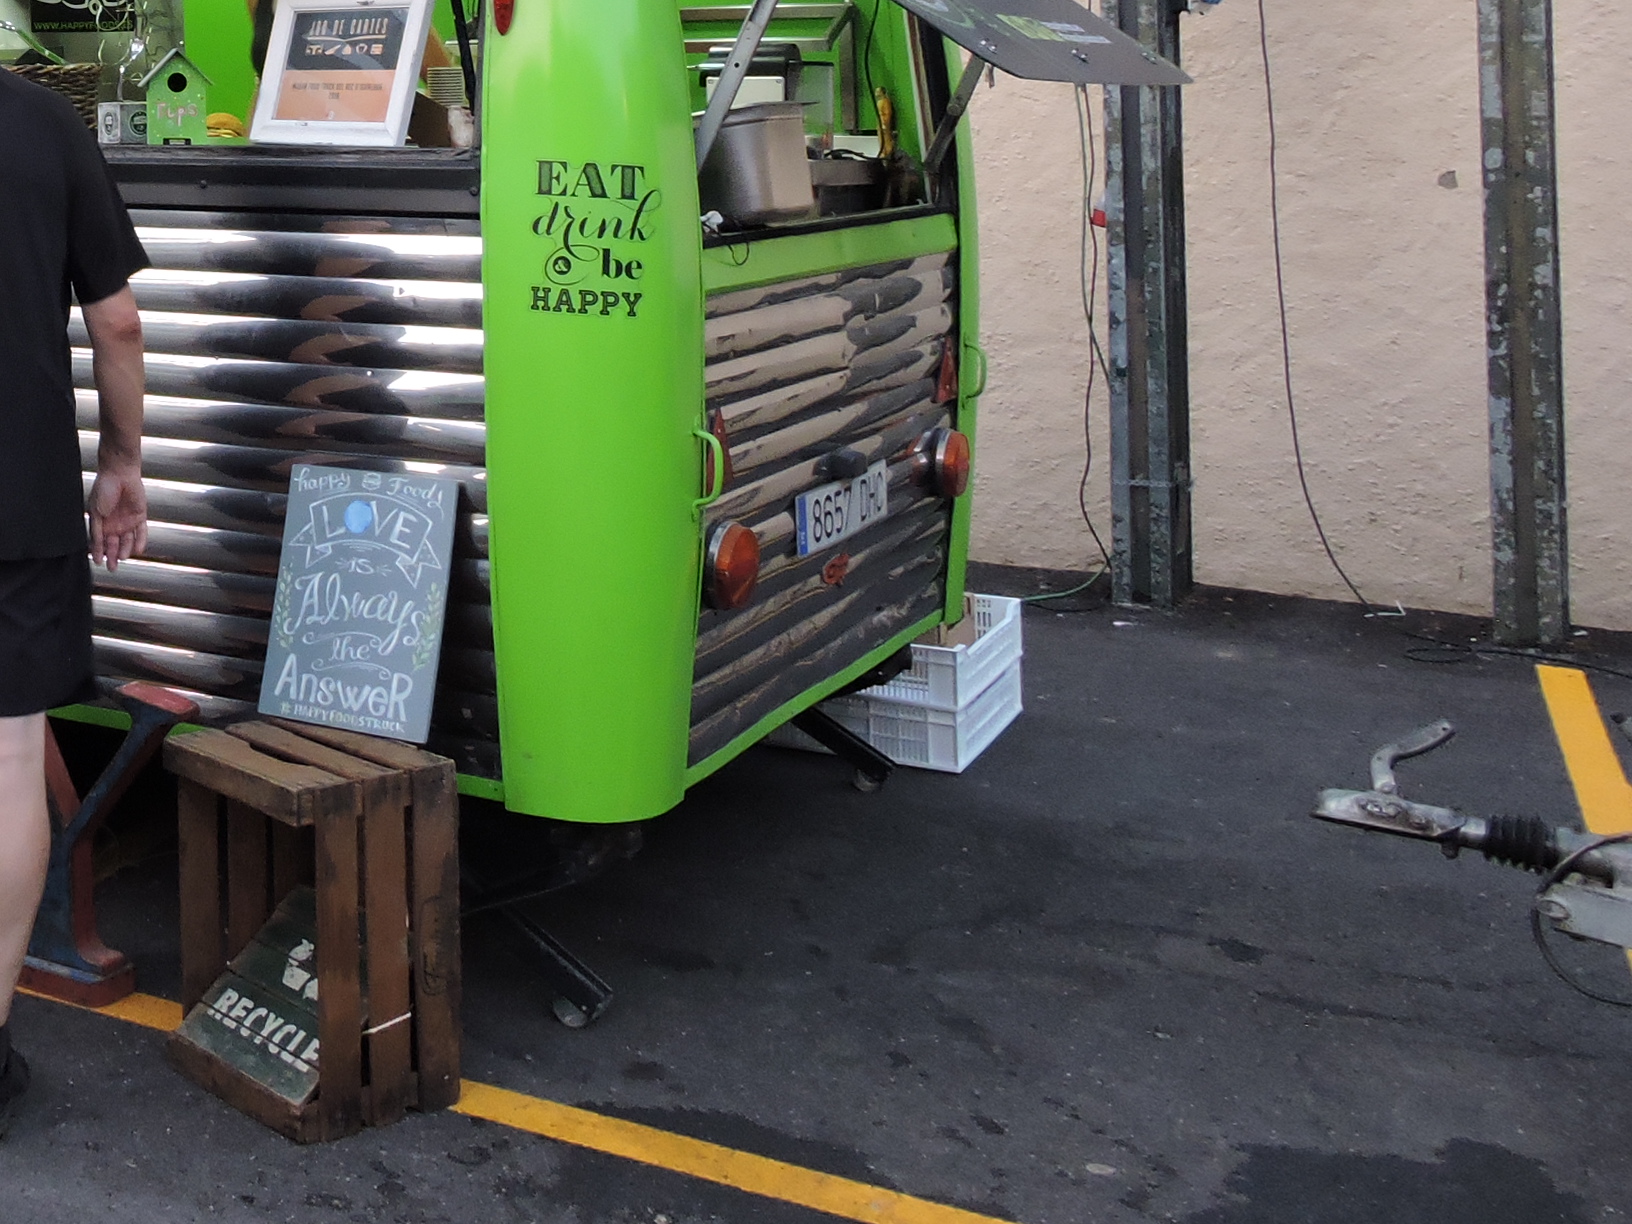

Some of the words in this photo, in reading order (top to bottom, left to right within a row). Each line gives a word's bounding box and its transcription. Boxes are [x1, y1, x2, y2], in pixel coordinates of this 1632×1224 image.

[156, 102, 198, 126] Tips
[534, 159, 646, 201] EAT
[532, 189, 662, 262] drink
[601, 247, 643, 280] be
[530, 286, 643, 317] HAPPY
[812, 487, 853, 543] 8657
[283, 572, 425, 656] Always
[331, 635, 371, 662] the
